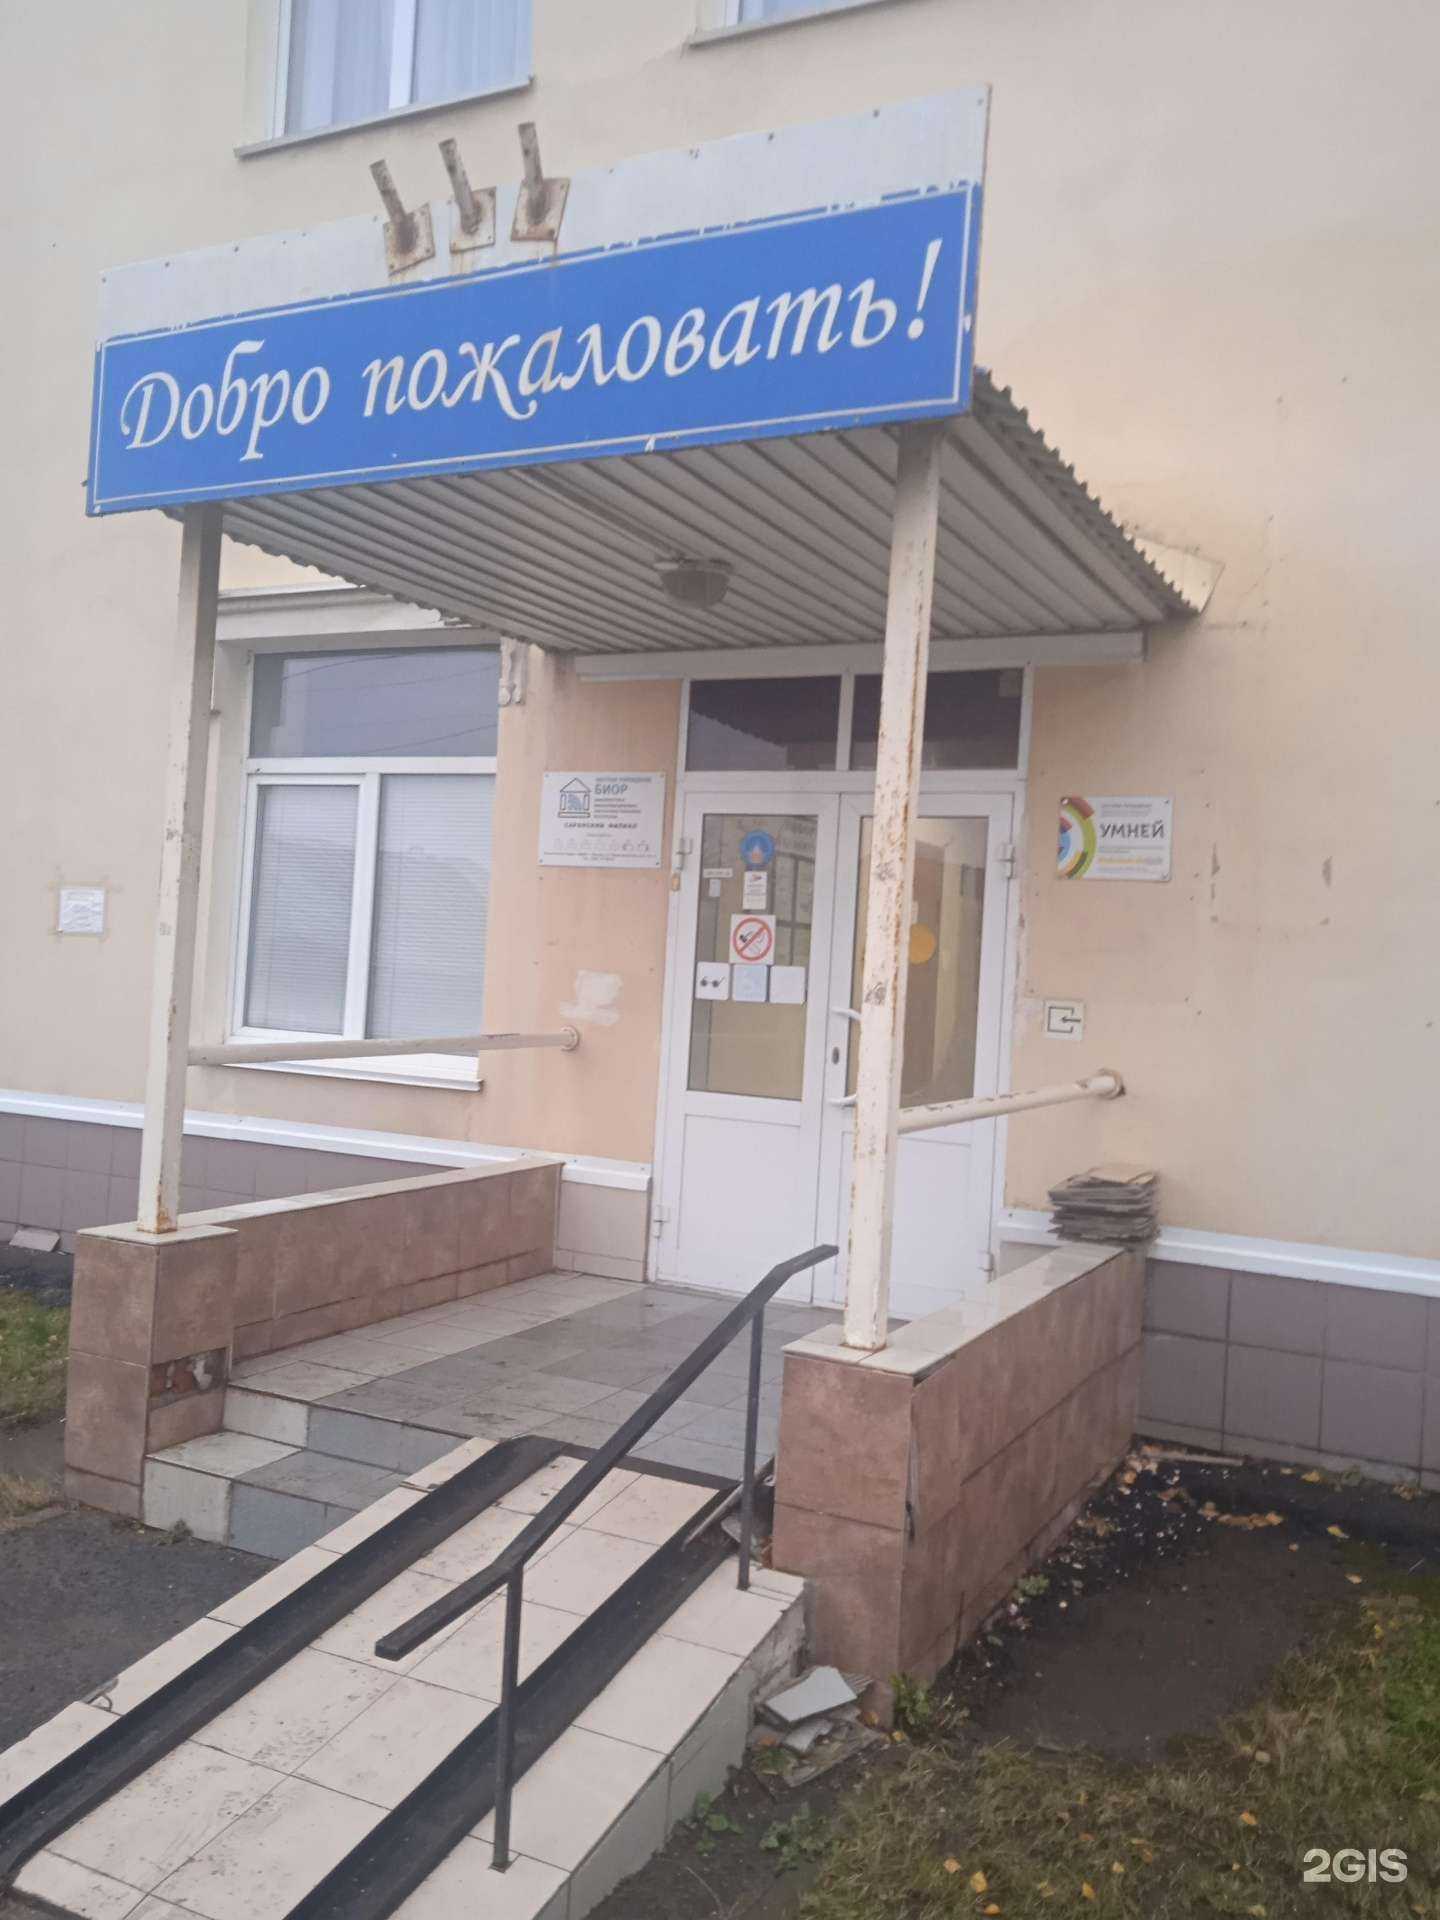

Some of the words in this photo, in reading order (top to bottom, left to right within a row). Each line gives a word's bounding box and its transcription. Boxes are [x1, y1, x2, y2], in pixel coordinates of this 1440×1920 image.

[120, 339, 331, 461] Добро
[361, 238, 943, 421] пожаловать!
[594, 783, 628, 795] БИОР
[1100, 819, 1165, 839] УМНЕЙ
